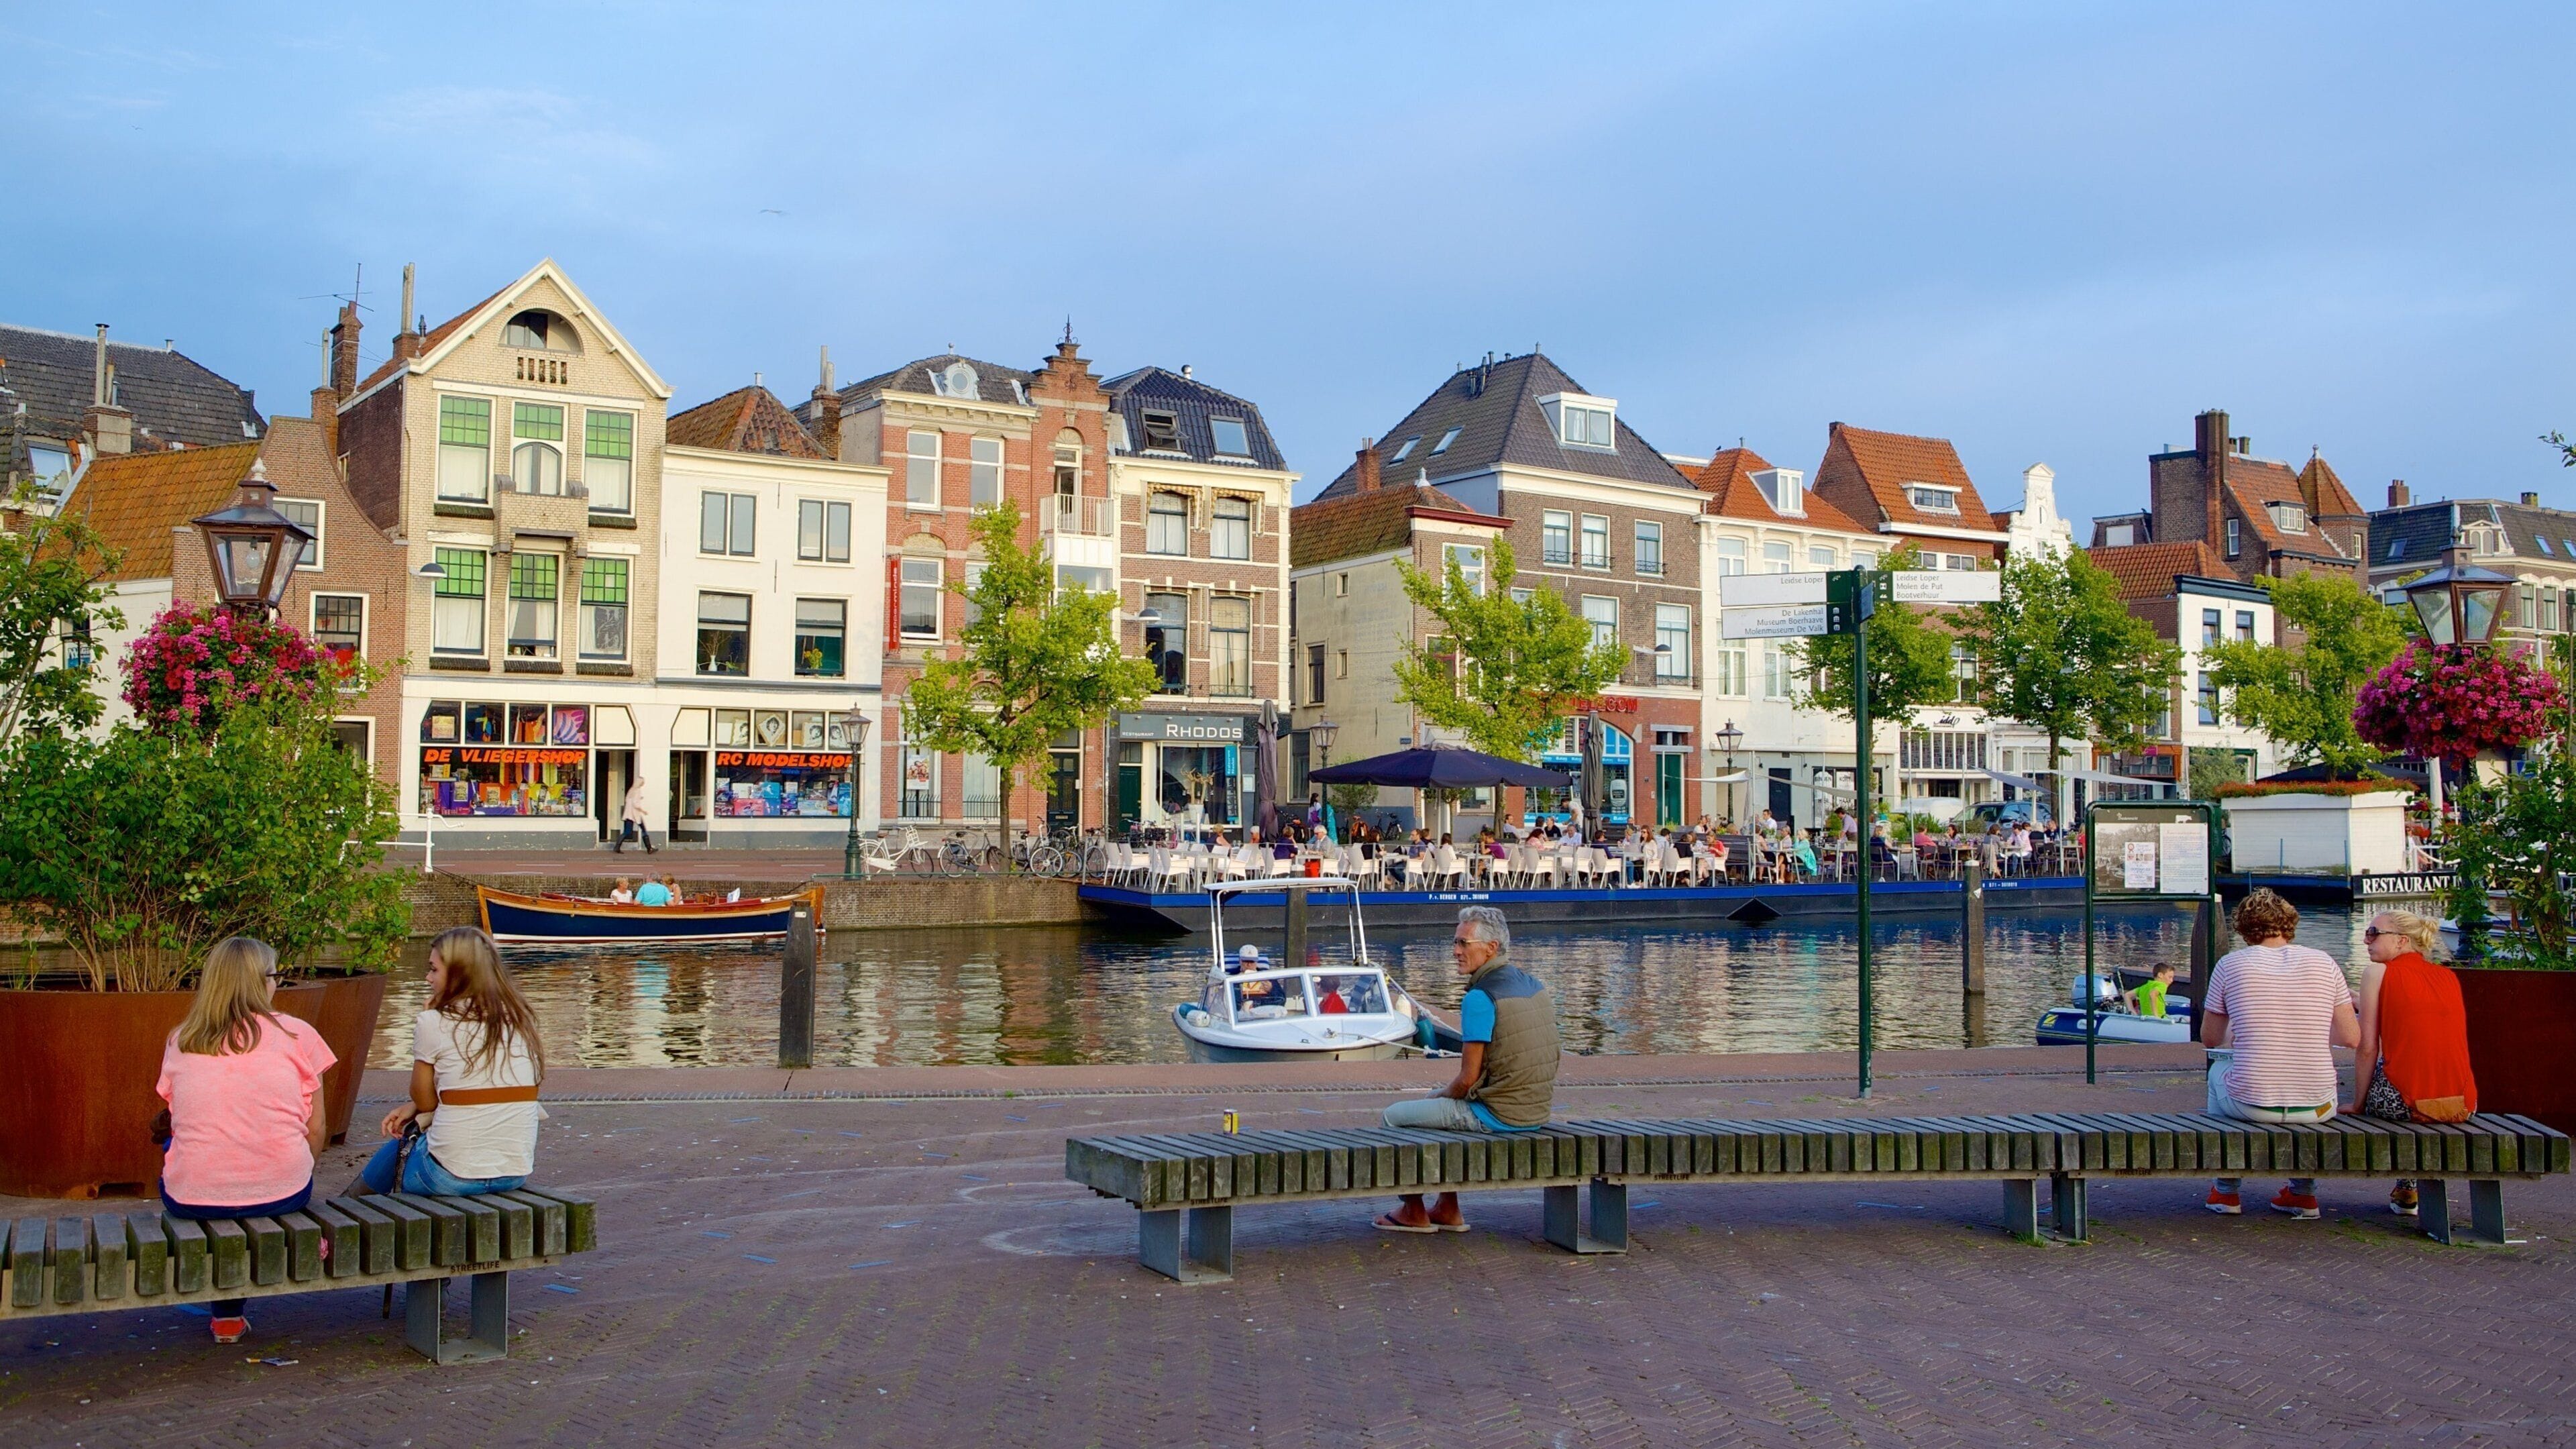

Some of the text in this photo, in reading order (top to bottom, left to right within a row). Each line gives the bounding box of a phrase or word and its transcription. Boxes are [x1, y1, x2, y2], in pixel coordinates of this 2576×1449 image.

[1920, 574, 1939, 582] Loper
[1794, 607, 1823, 616] Lakenhal
[1788, 616, 1823, 625] Boerhaave
[425, 749, 586, 764] DE VLIEGERSHOP
[717, 753, 743, 765] RC
[2363, 875, 2450, 894] RESTAURANT
[451, 1261, 499, 1273] STREETLIFE
